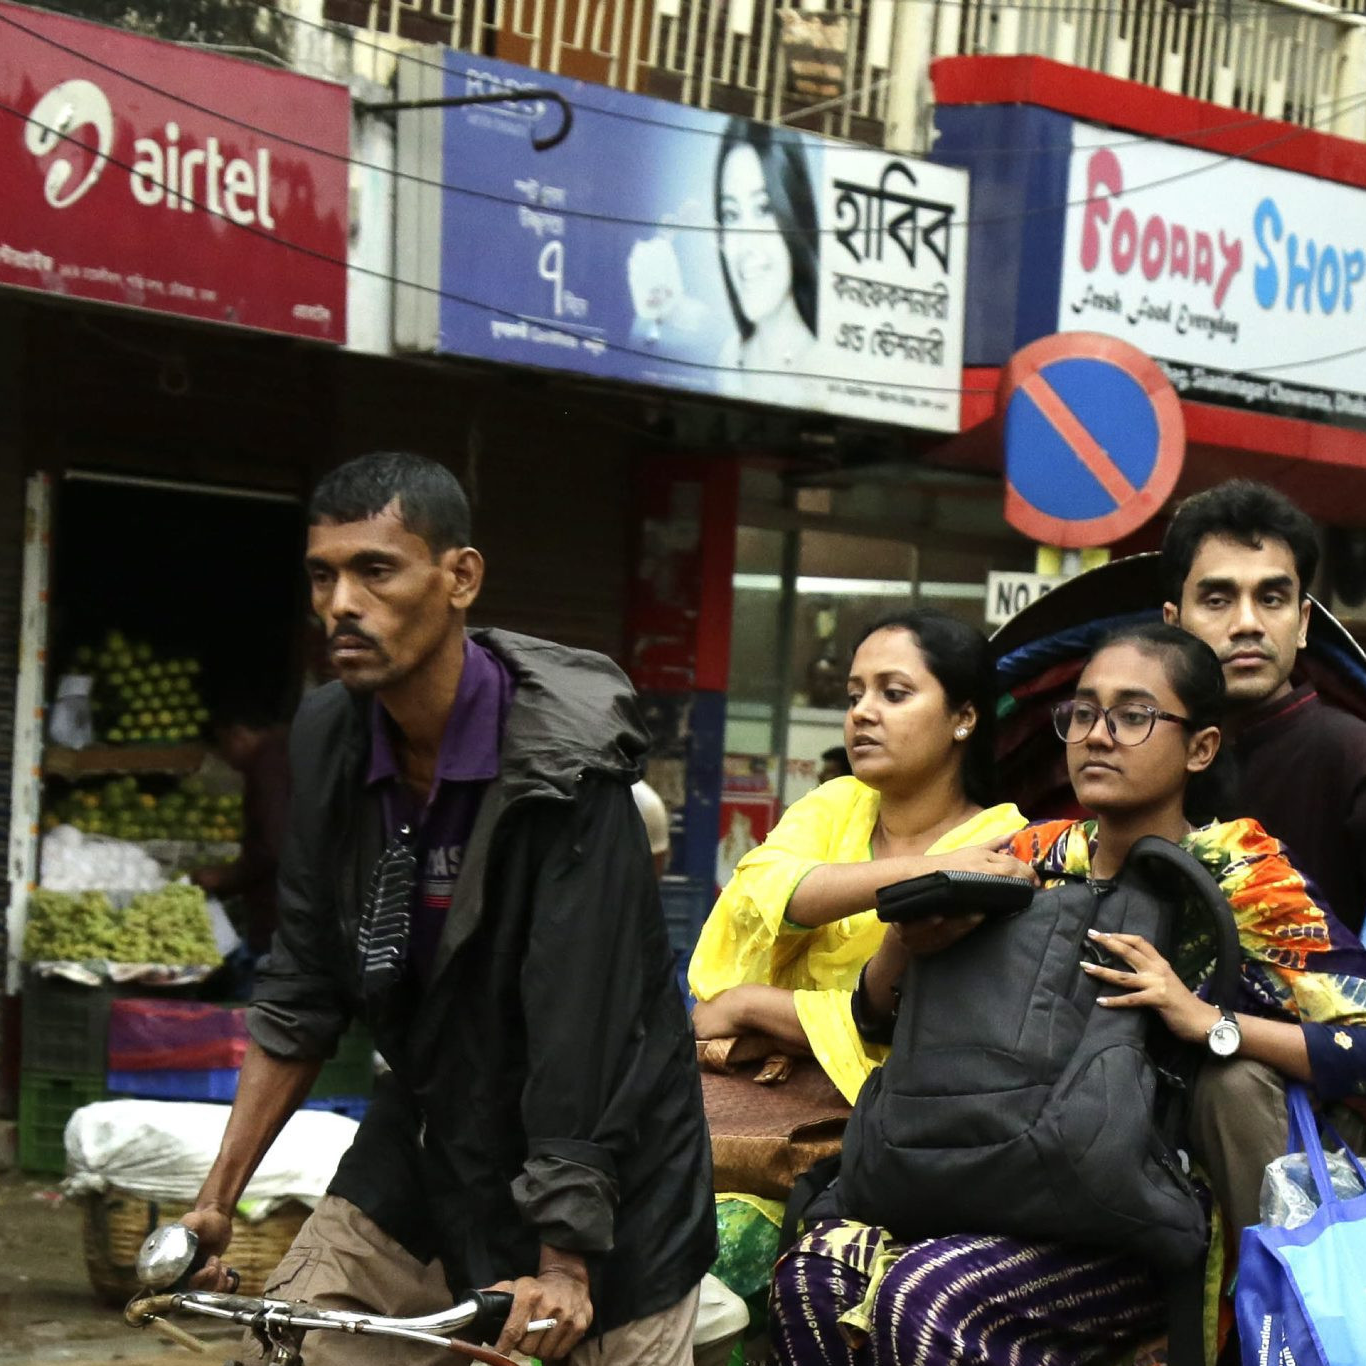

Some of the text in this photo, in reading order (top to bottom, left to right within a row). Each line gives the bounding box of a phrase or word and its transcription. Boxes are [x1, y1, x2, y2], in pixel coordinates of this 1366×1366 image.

[130, 121, 275, 230] airtel
[831, 162, 955, 275] হাবিব
[1071, 284, 1241, 344] Fresh Food Everyday
[996, 580, 1029, 615] NO
